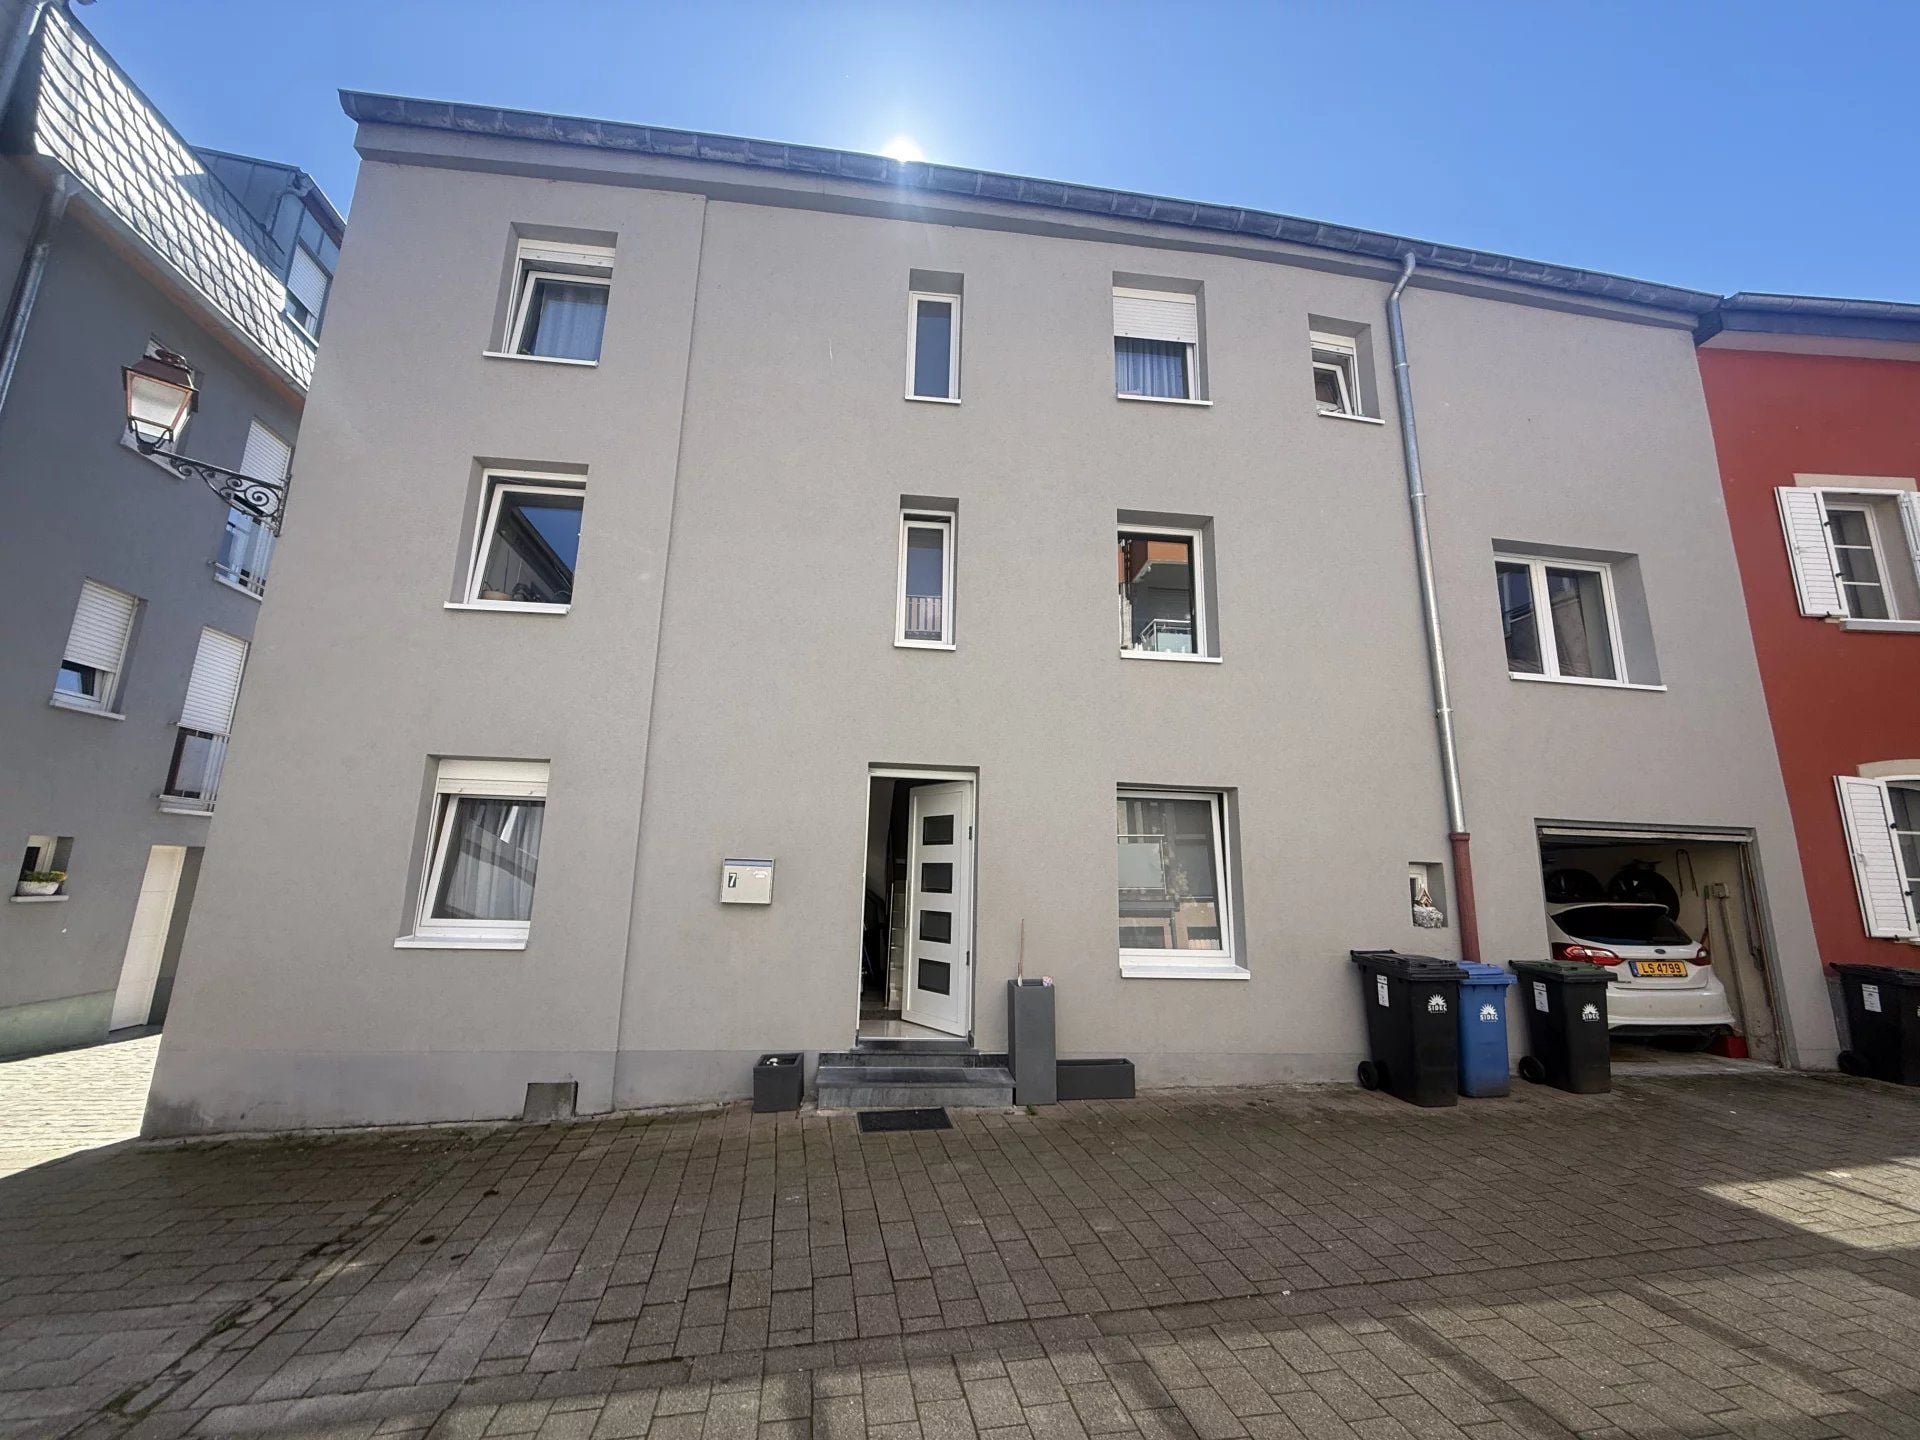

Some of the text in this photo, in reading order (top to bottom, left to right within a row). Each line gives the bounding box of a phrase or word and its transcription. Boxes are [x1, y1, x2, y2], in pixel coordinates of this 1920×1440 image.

[729, 873, 737, 887] 7
[1641, 963, 1681, 973] LS 4799
[1427, 1004, 1447, 1012] SIDEC
